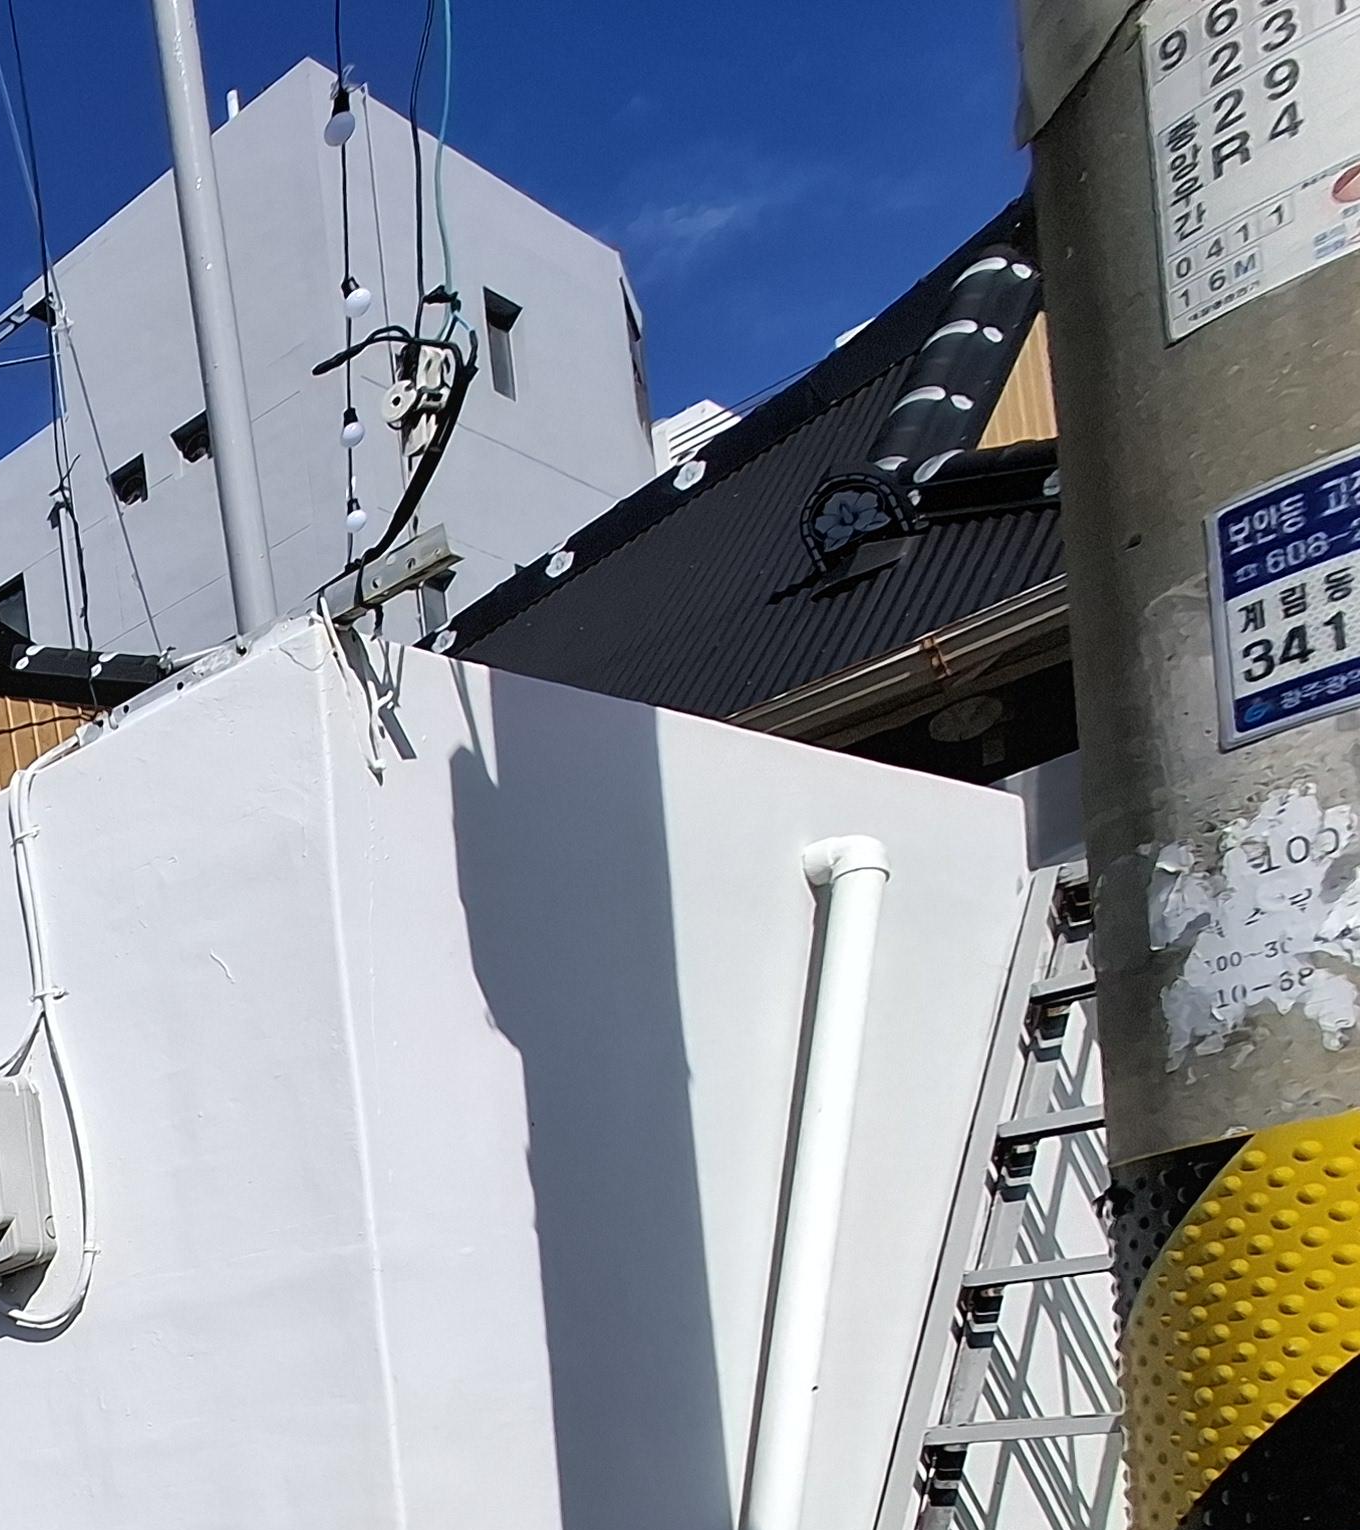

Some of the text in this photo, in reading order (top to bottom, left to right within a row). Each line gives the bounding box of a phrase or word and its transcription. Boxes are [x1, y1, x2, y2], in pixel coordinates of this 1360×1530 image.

[1228, 492, 1307, 556] 보안등
[1237, 565, 1356, 634] 계림동
[1241, 609, 1347, 683] 341
